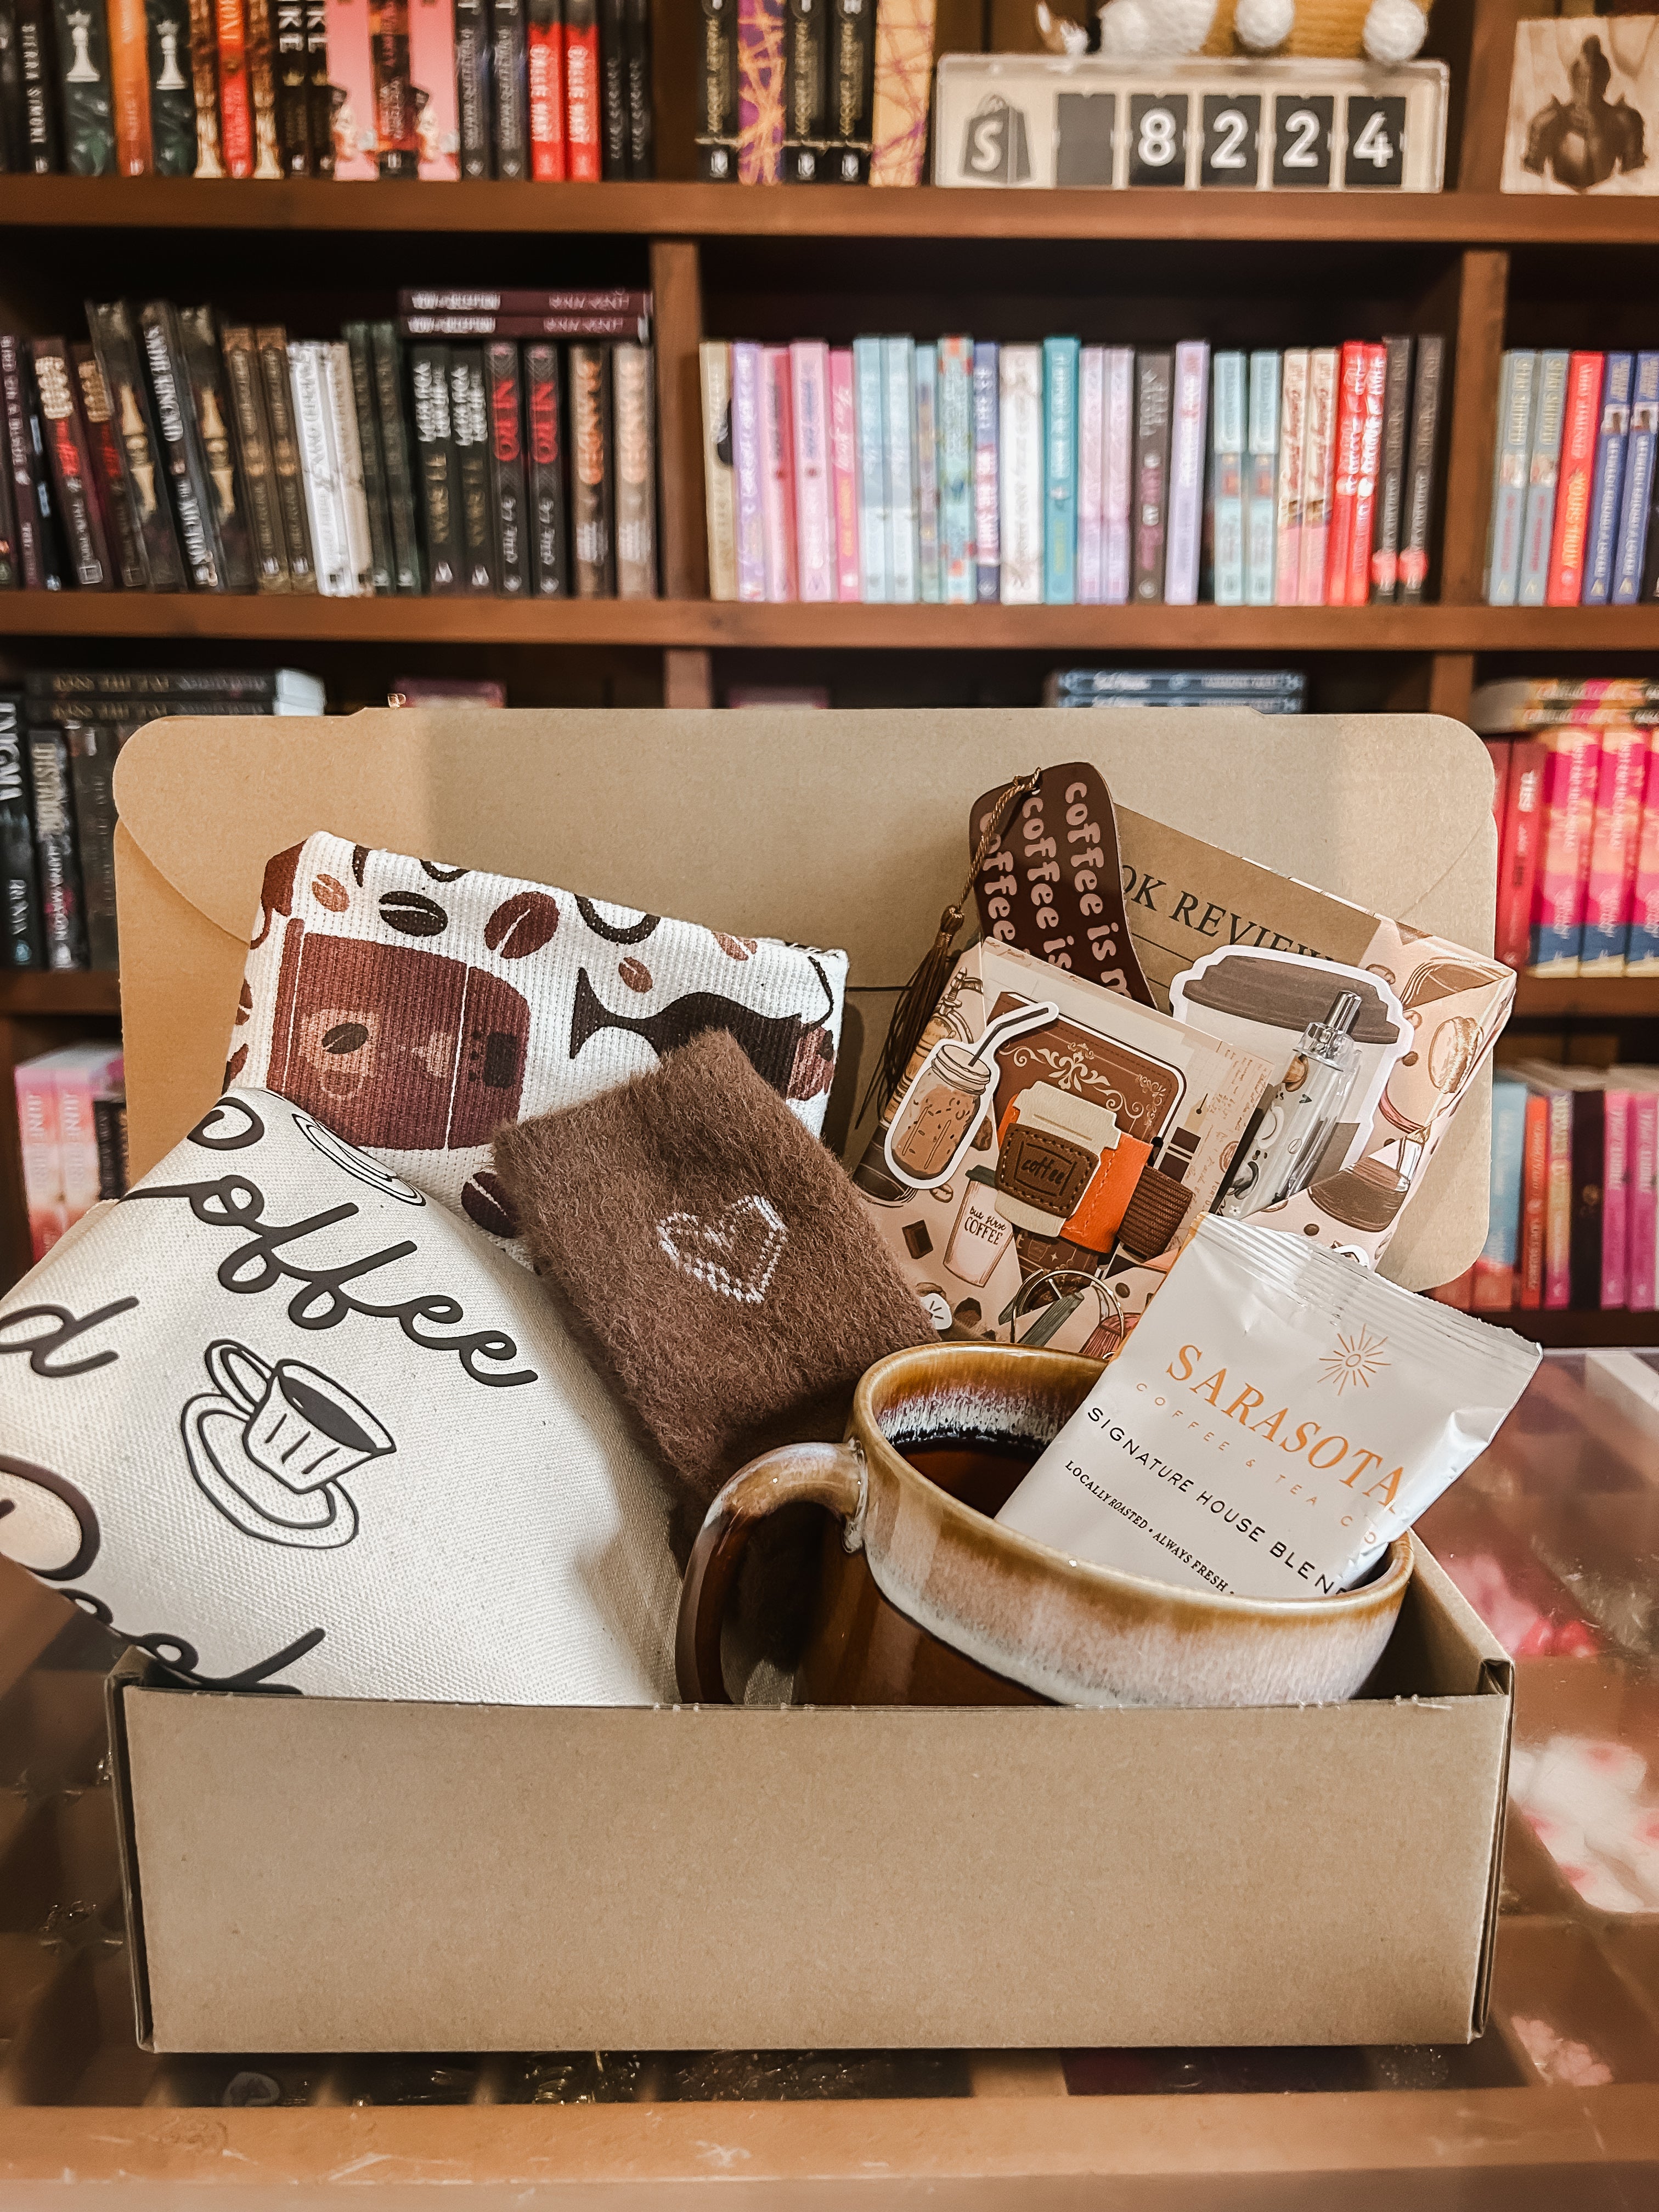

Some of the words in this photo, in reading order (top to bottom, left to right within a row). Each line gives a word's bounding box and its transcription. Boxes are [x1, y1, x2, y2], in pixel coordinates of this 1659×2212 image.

[1022, 797, 1060, 930] coffee
[1065, 782, 1104, 917] coffee
[1087, 923, 1119, 961] is
[1169, 890, 1335, 961] REVIE
[964, 1216, 1003, 1245] COFFEE
[969, 1206, 984, 1219] but
[985, 1215, 1006, 1231] first
[1020, 1155, 1065, 1186] coffee
[1087, 1407, 1194, 1493] SIGNATURE
[1195, 1488, 1266, 1543] HOUSE
[1136, 1383, 1229, 1452] COFFEE
[1246, 1458, 1255, 1469] &
[1276, 1474, 1317, 1506] TEA
[1166, 1344, 1404, 1514] SARASOTA
[1065, 1459, 1112, 1503] LOCALLY
[1109, 1497, 1149, 1530] ROASTED
[1152, 1531, 1193, 1565] ALWAYS
[1190, 1559, 1229, 1593] FRESH
